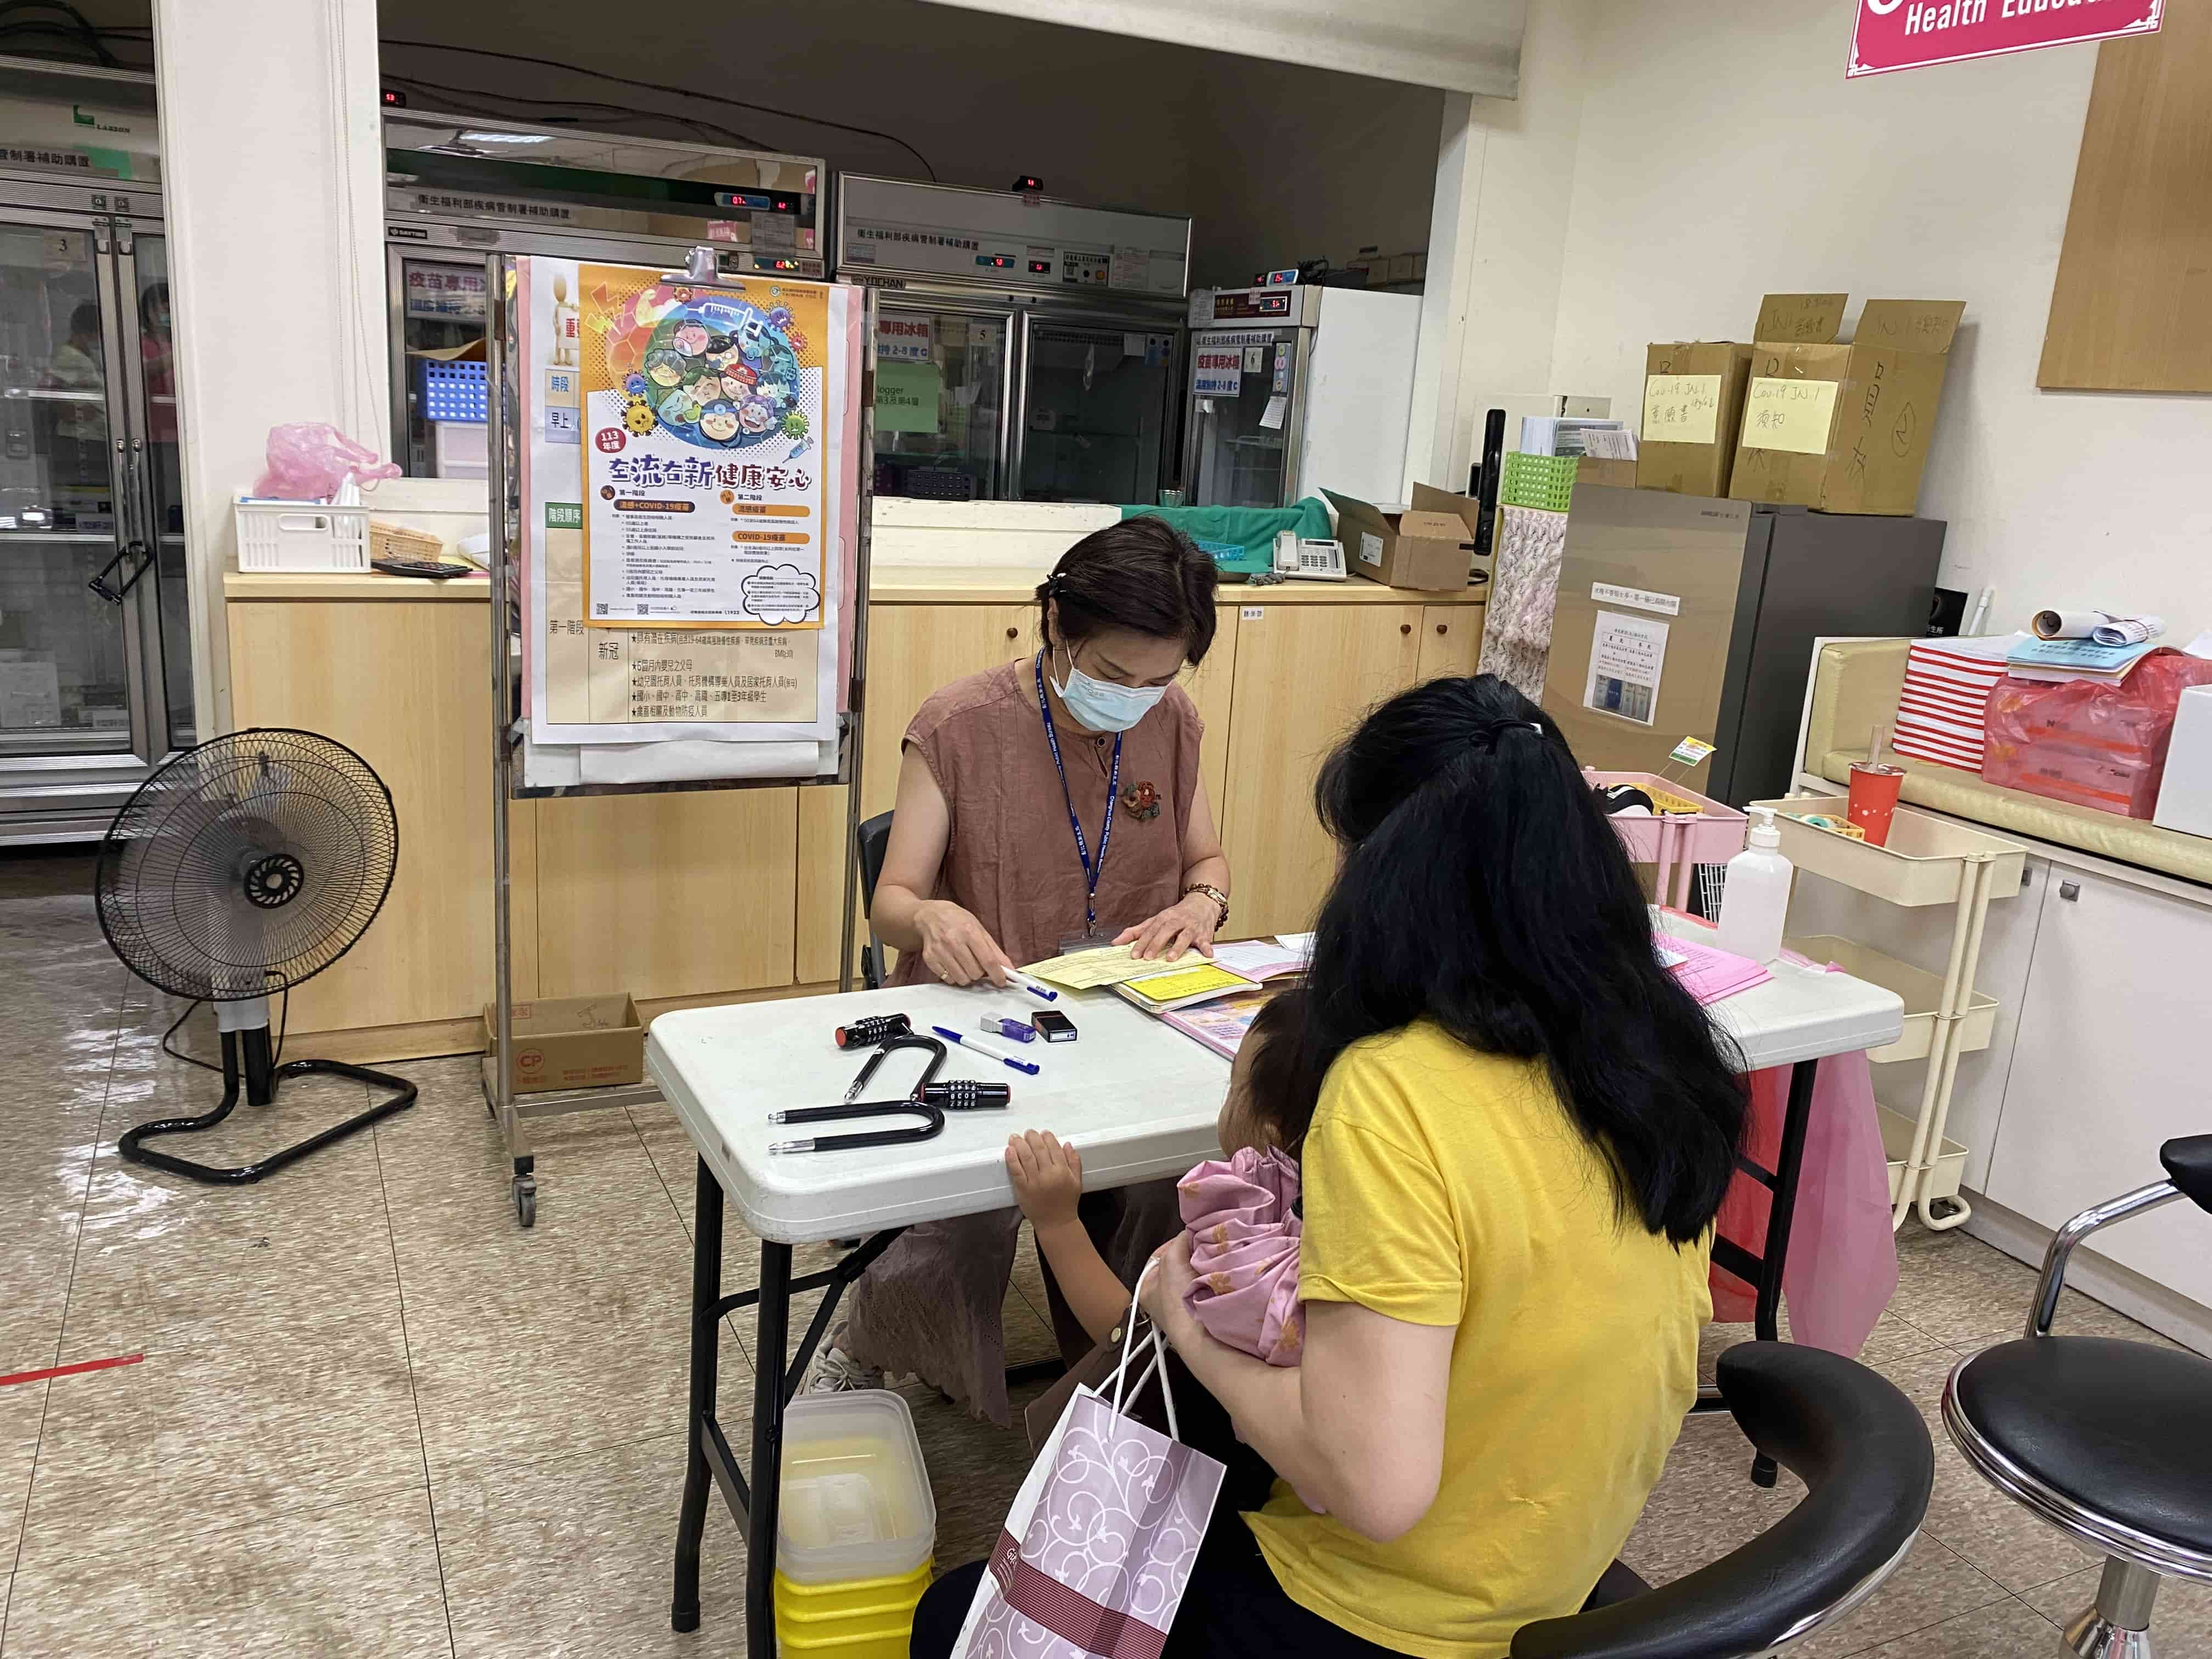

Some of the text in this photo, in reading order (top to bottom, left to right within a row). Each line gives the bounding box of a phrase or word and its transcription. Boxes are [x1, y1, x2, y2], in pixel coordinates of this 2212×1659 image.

[1905, 0, 1987, 35] Health
[417, 194, 571, 219] 衛生福利部疾病管制署補助購置
[59, 239, 68, 252] 3
[857, 229, 979, 251] 衛生福利部疾病管制署補助購置
[979, 329, 987, 340] 5
[1197, 354, 1240, 369] 疫苗專用冰箱
[1250, 353, 1255, 365] 6
[551, 375, 569, 392] 時段
[551, 411, 569, 428] 早上
[601, 431, 619, 442] 113
[602, 441, 620, 450] 年度
[619, 500, 690, 511] 流感+COVID-19疫苗
[548, 507, 582, 523] 階段順序
[737, 533, 786, 541] COVID-19疫苗
[549, 619, 584, 635] 第一階段
[598, 641, 619, 660] 新冠
[520, 1054, 542, 1068] CP
